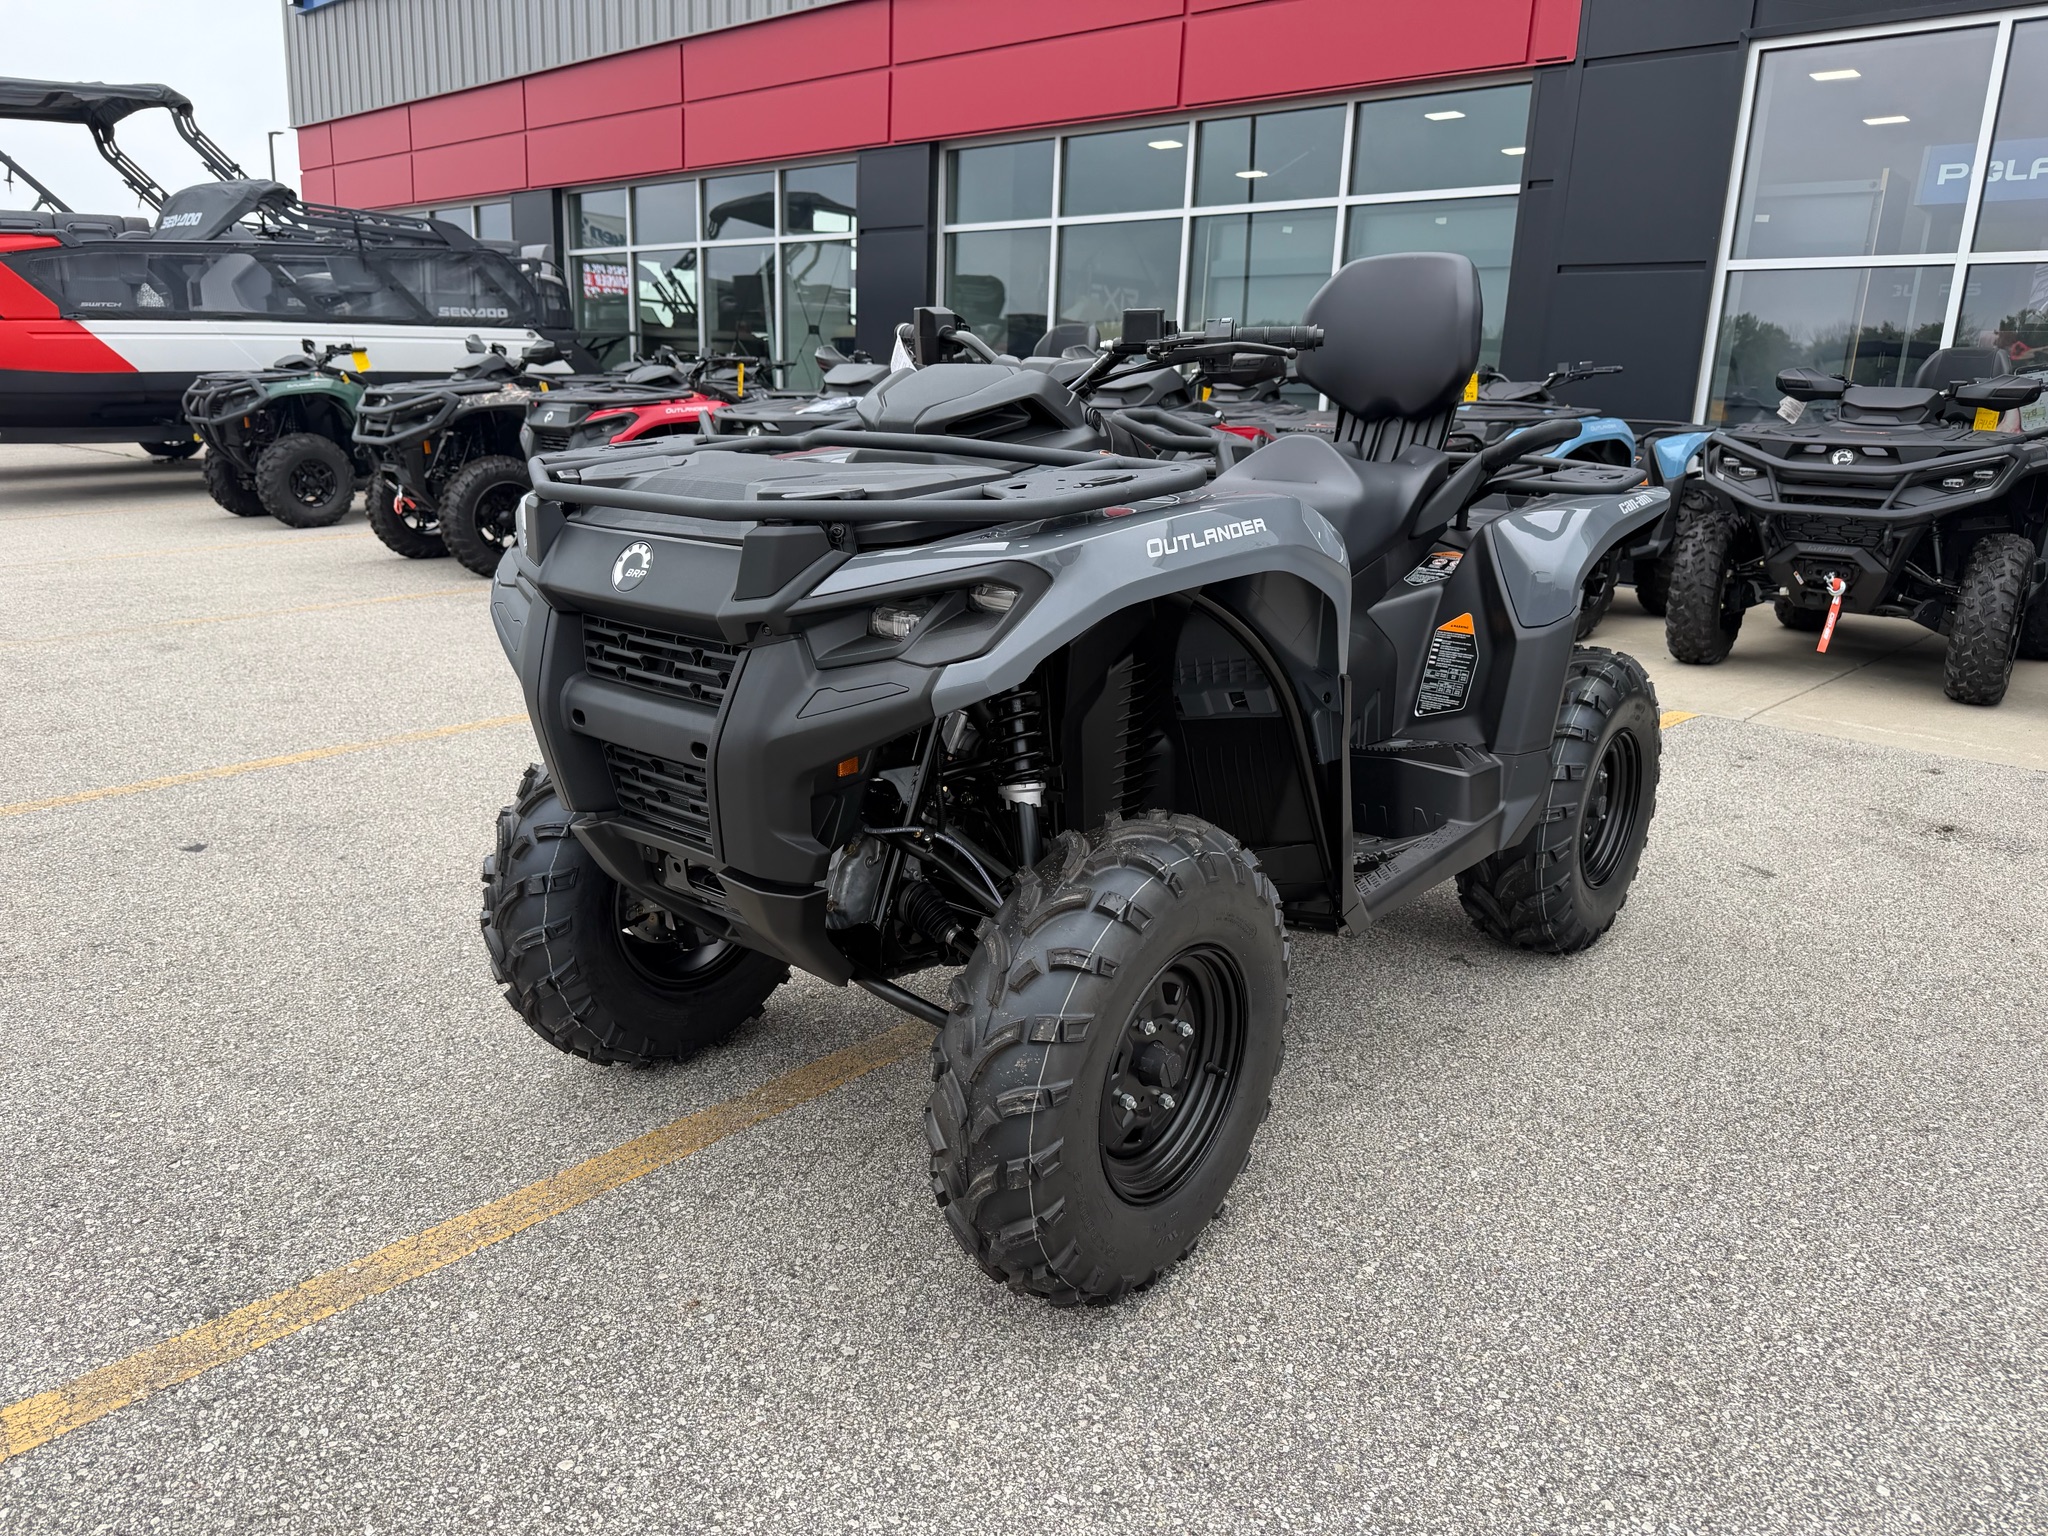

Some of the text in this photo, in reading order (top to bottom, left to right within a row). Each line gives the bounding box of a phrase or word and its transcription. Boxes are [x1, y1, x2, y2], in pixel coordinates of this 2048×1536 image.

[665, 405, 709, 415] OUTLANDER
[1146, 517, 1267, 559] OUTLANDER
[625, 568, 648, 578] BRP
